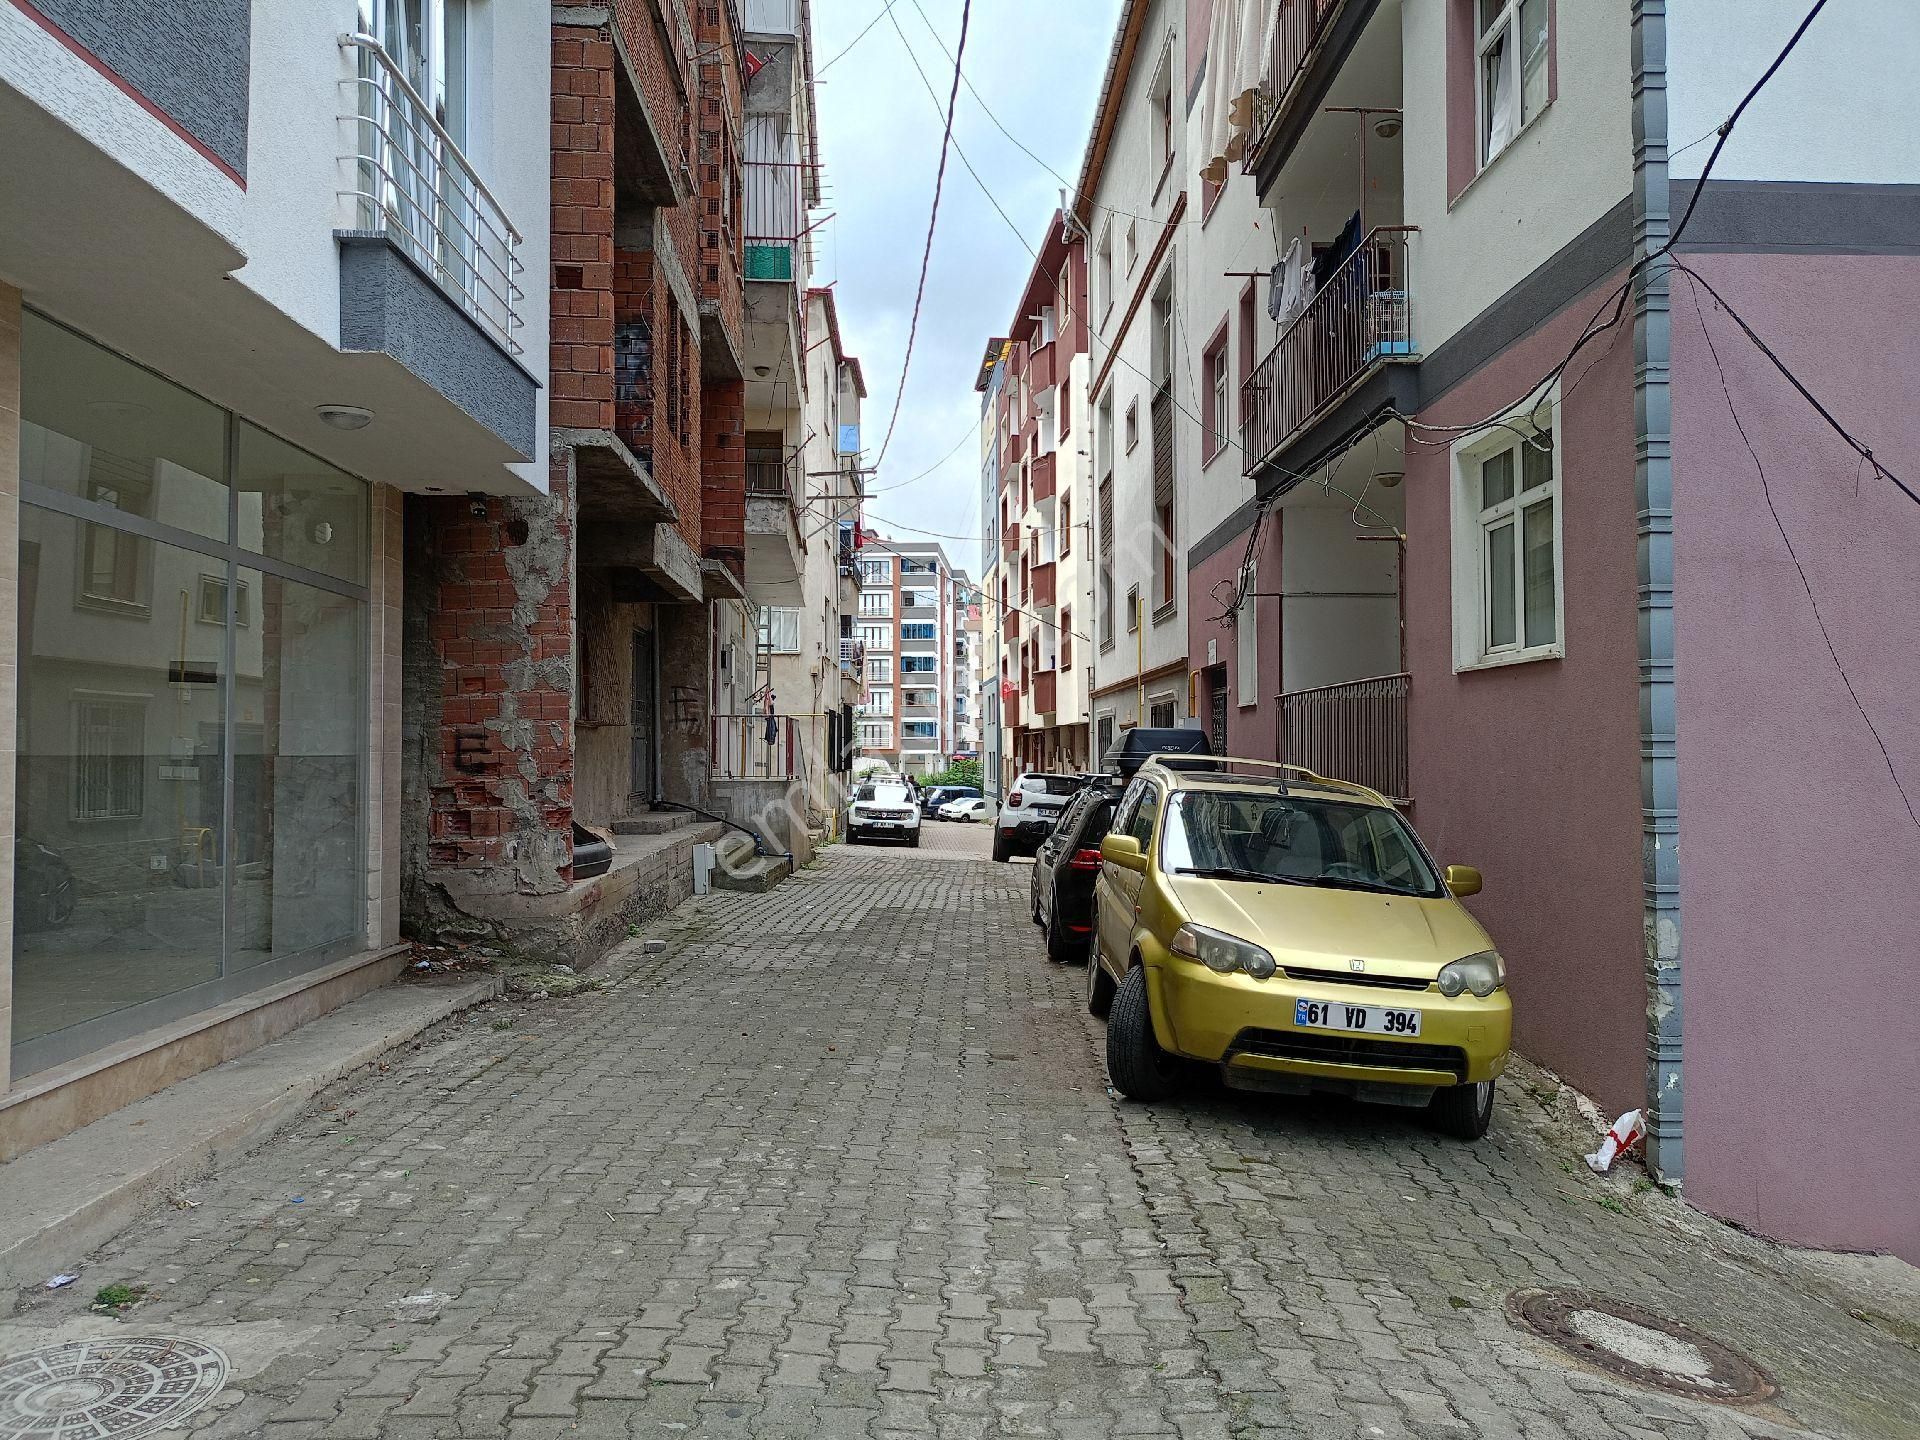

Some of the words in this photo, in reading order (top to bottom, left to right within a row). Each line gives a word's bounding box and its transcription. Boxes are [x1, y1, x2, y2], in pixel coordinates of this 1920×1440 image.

[1308, 1004, 1329, 1025] 61
[1345, 1007, 1367, 1029] VD
[1384, 1011, 1417, 1034] 394
